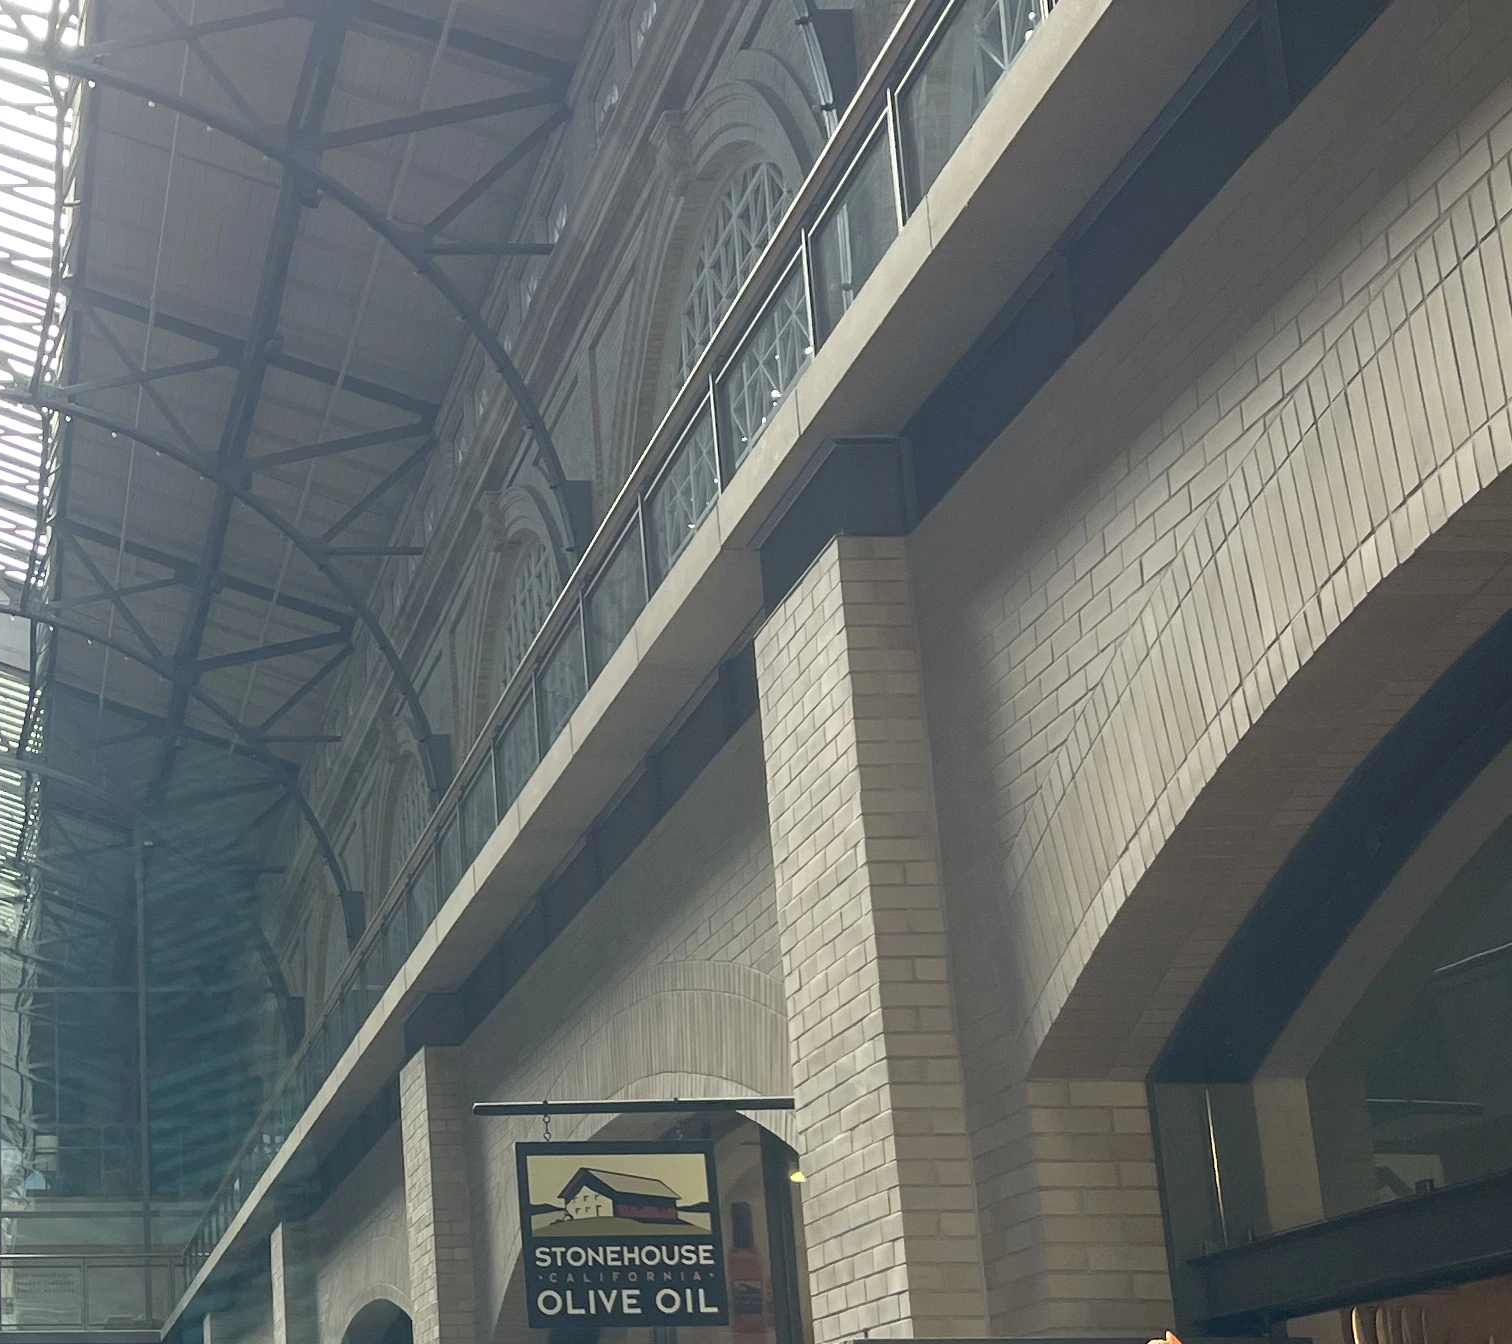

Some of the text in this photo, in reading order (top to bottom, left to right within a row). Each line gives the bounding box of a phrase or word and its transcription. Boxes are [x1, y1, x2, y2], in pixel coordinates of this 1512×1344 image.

[535, 1245, 716, 1268] STONEHOUSE
[549, 1271, 702, 1284] CALIFORNIA
[537, 1288, 642, 1316] OLIVE
[655, 1287, 720, 1315] OIL
